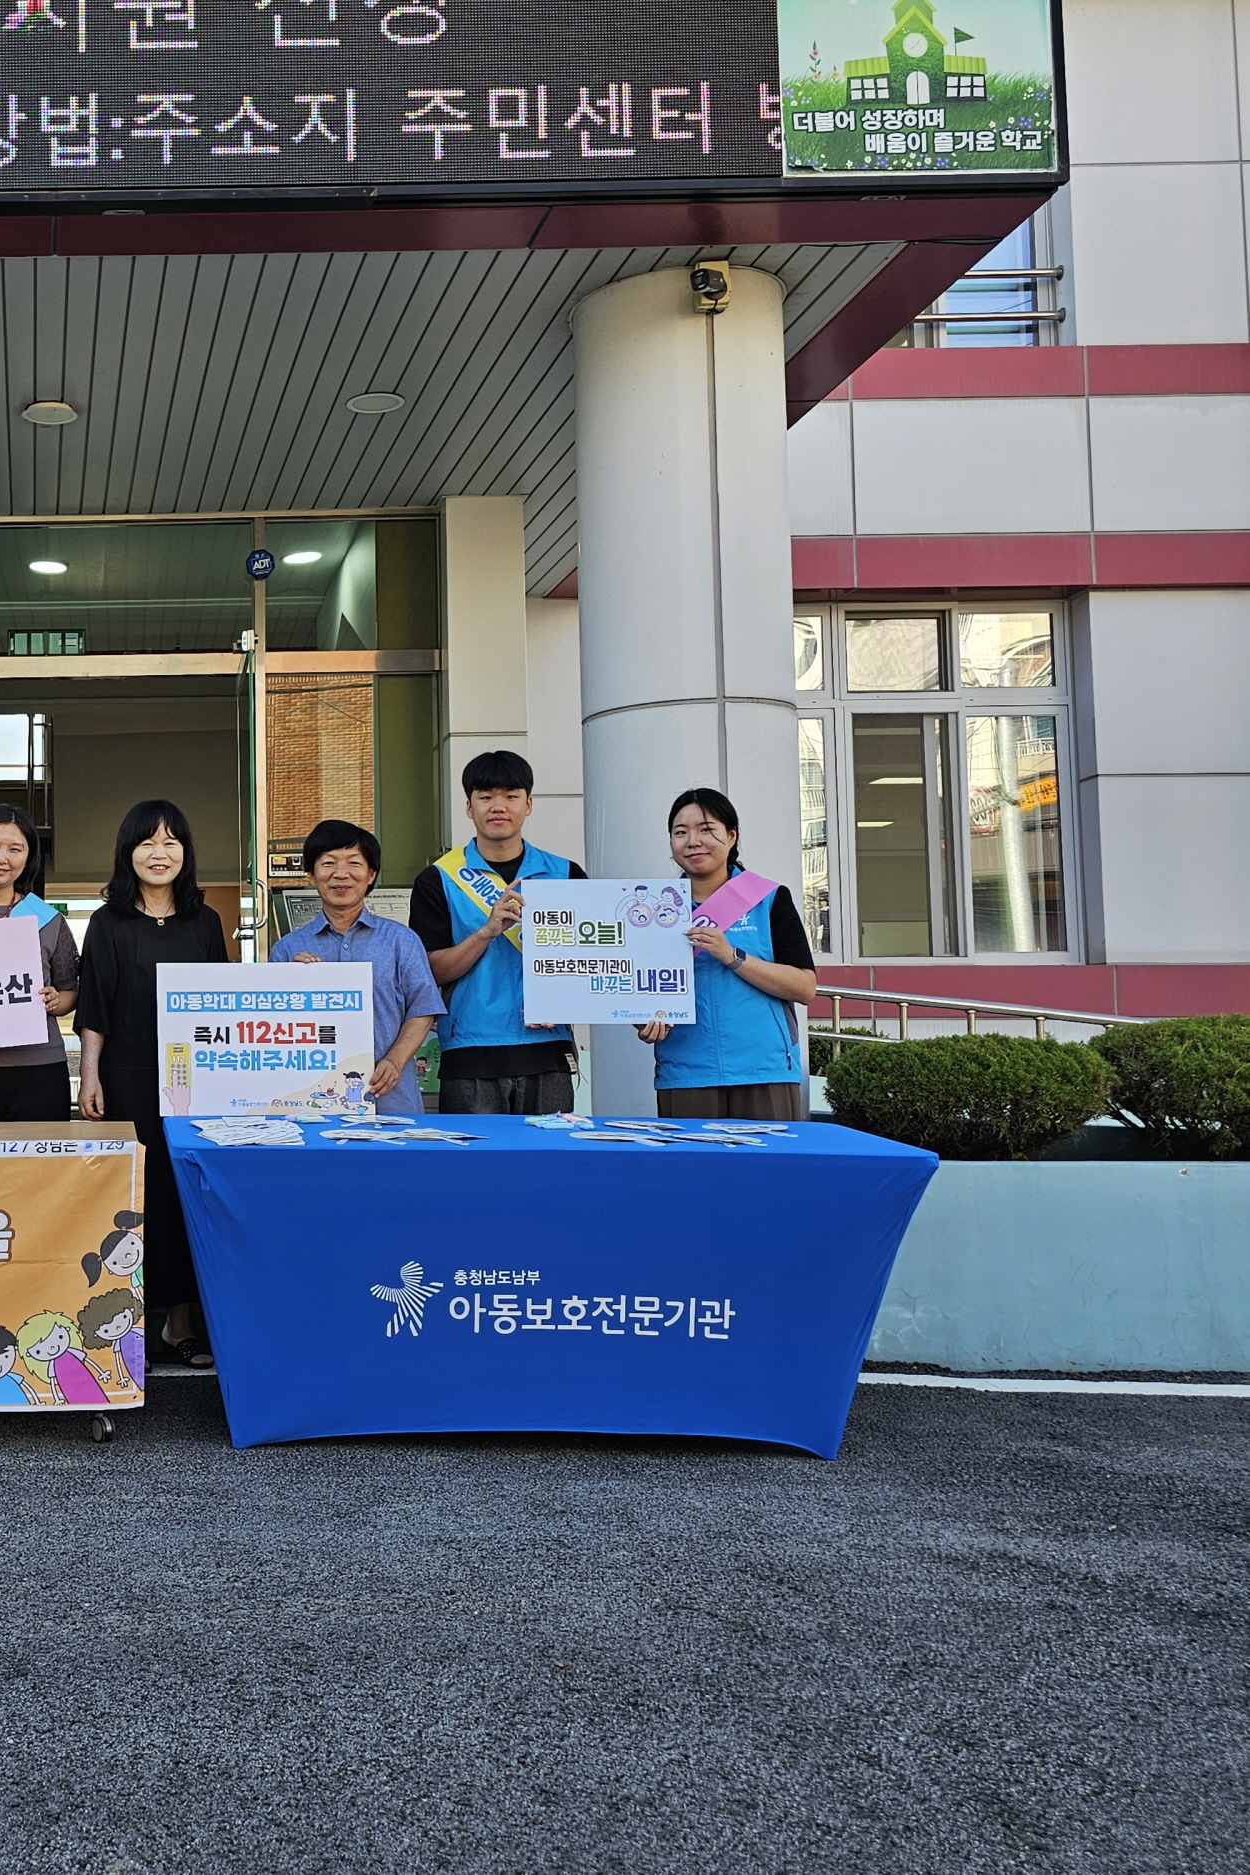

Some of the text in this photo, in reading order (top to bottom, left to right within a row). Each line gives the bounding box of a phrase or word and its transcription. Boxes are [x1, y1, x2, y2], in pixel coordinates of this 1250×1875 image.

[402, 80, 713, 160] 주민센터
[793, 108, 946, 133] 더불어 성장하며
[864, 129, 1043, 154] 배움이 즐거운 학교
[253, 558, 270, 570] ADT
[532, 910, 573, 926] 아동이
[534, 920, 624, 945] 꿈꾸는 오늘!
[533, 958, 631, 975] 아동보호전문기관이
[590, 968, 686, 993] 바꾸는 내일!
[170, 992, 360, 1010] 아동학대 의심상황 발견시
[193, 1020, 337, 1045] 즉시 112신고를
[194, 1049, 337, 1072] 약속해주세요!
[453, 1269, 541, 1286] 충청남도남부
[448, 1292, 737, 1340] 아동보호전문기관
